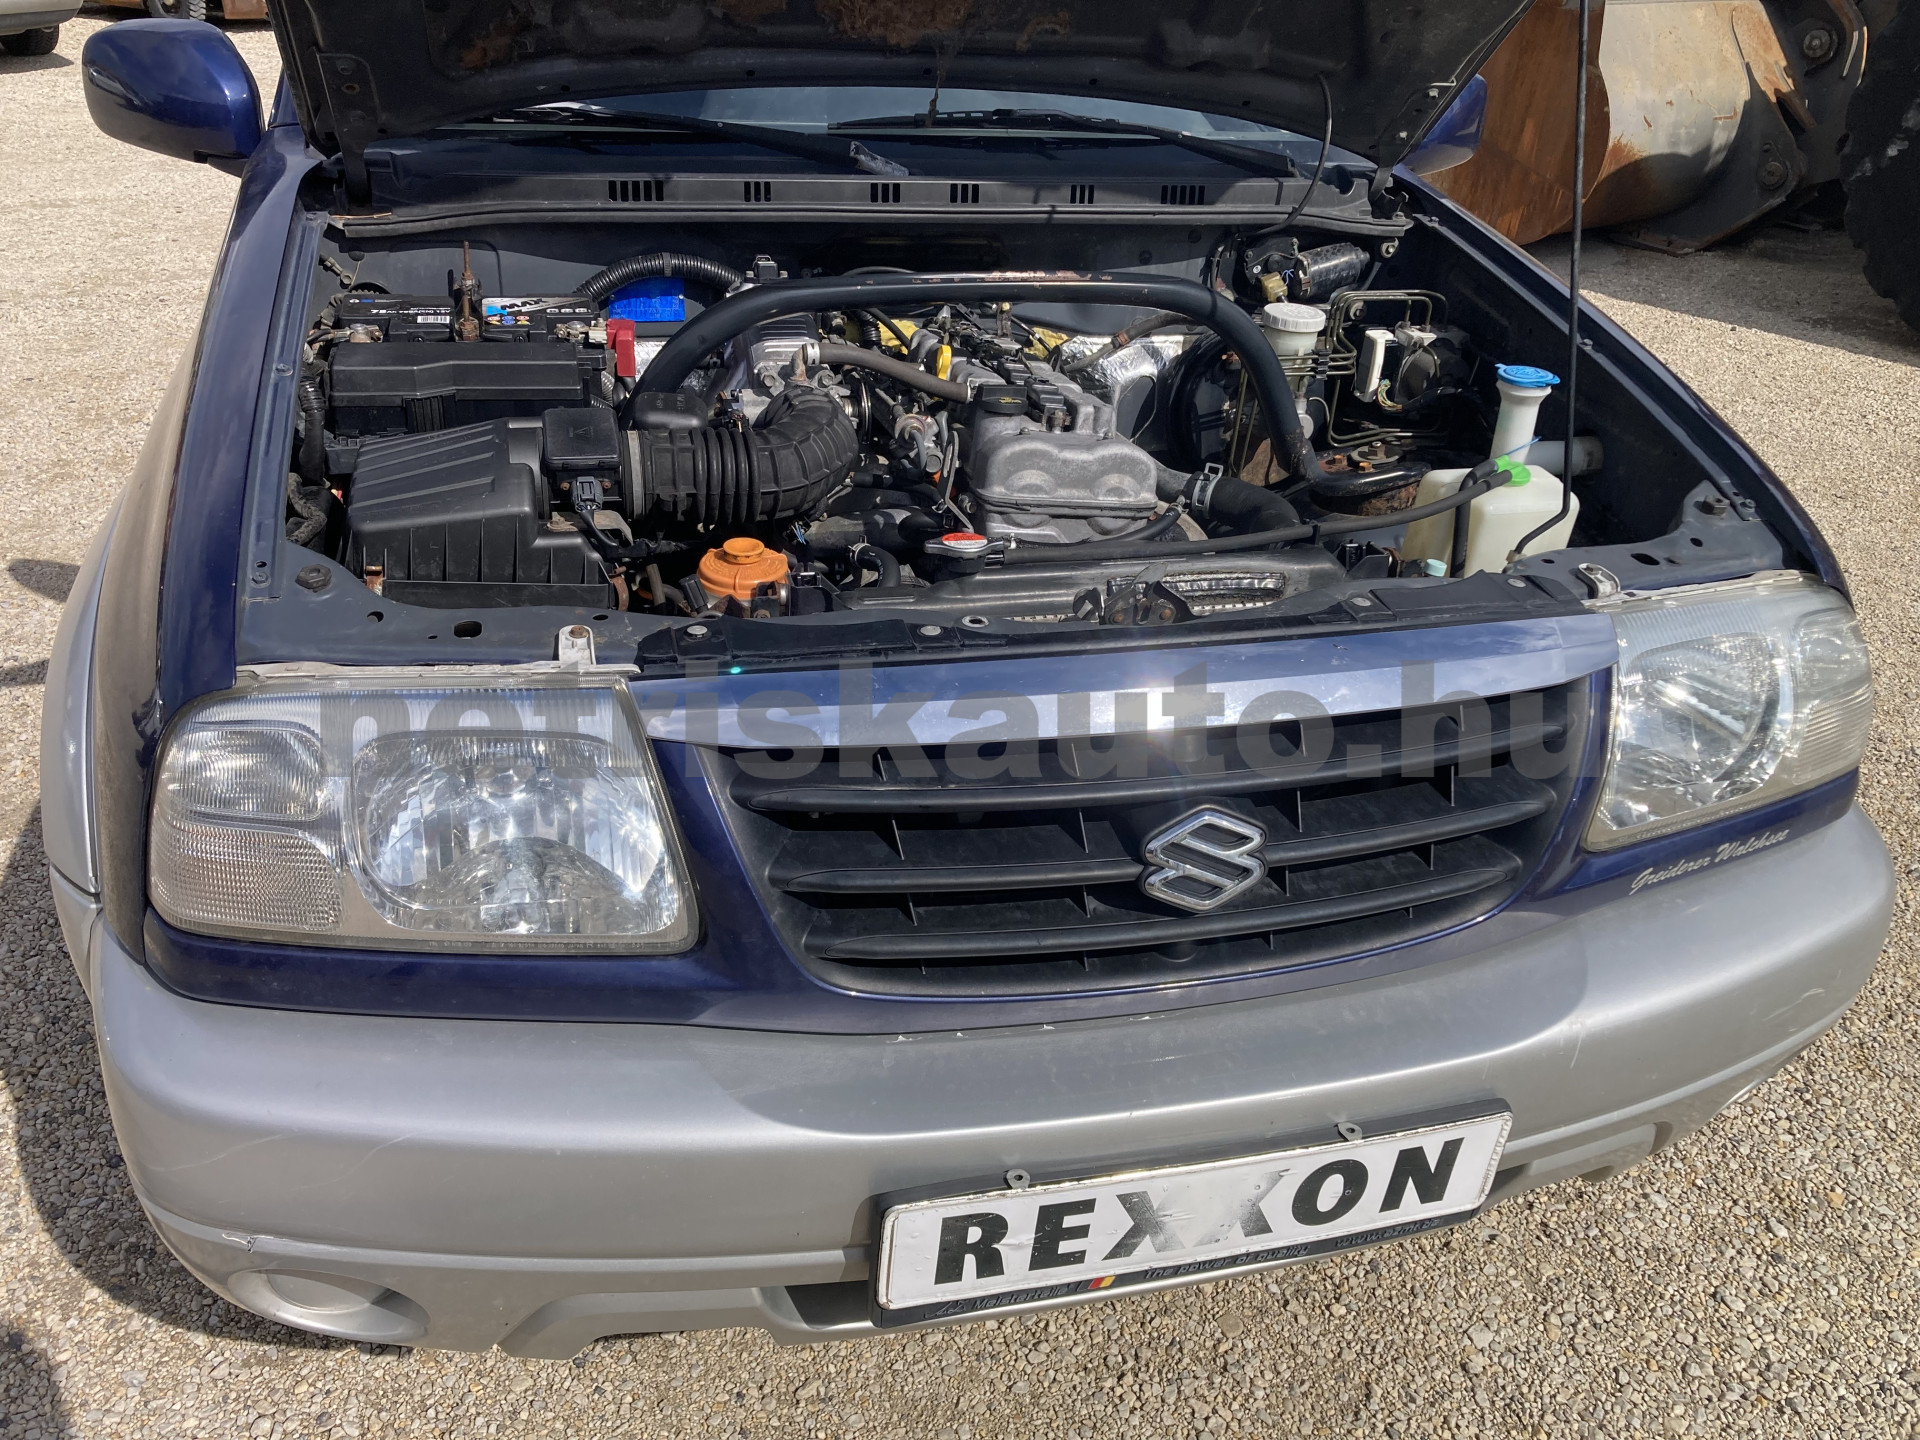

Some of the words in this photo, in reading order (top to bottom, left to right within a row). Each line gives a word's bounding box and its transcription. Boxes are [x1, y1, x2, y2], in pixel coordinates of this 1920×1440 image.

[500, 298, 548, 310] MAX
[1629, 855, 1712, 896] Greiderer
[1715, 828, 1790, 865] Walchsee
[1144, 1268, 1175, 1280] The
[1177, 1258, 1233, 1277] power
[1235, 1252, 1255, 1266] of
[1256, 1245, 1311, 1265] quality
